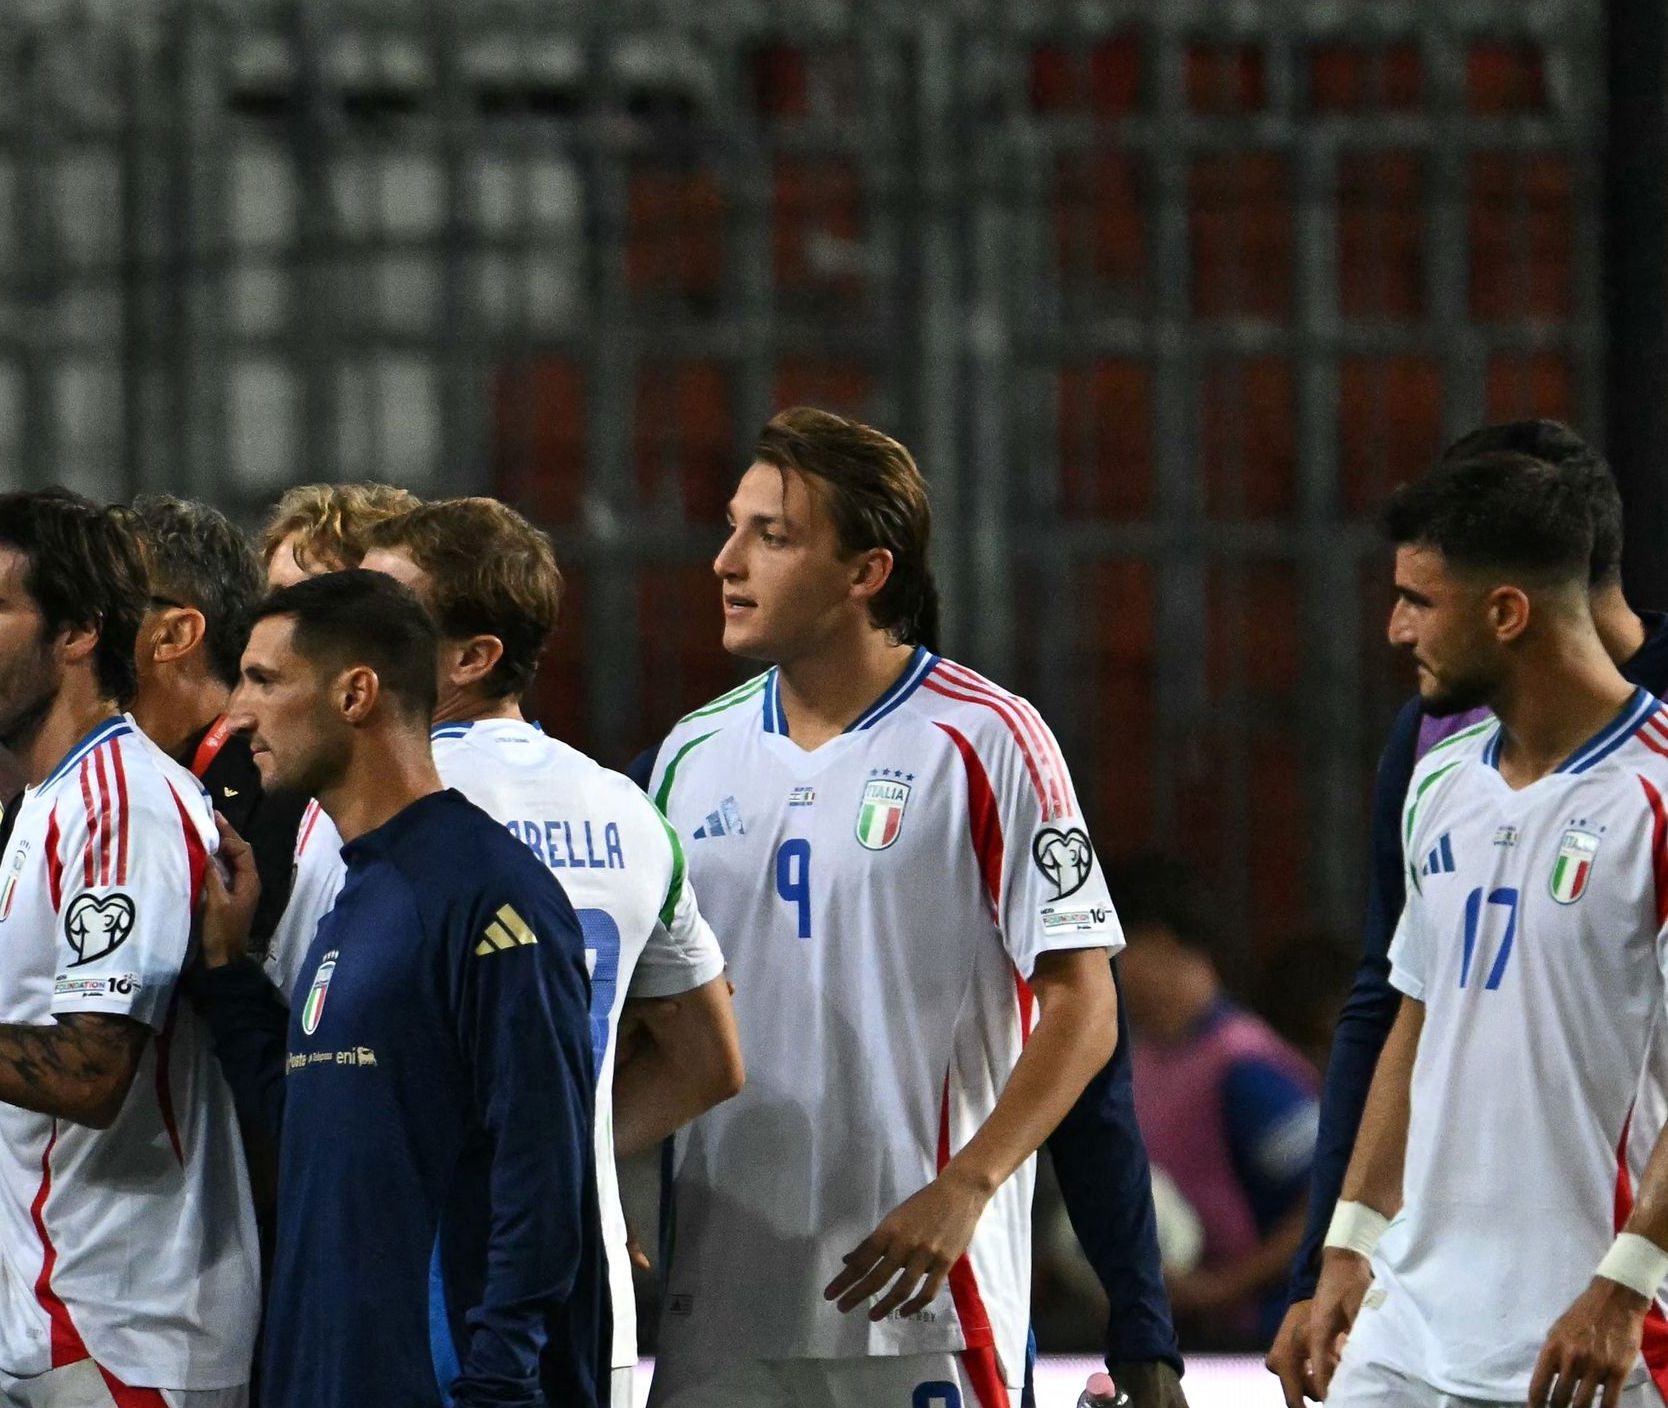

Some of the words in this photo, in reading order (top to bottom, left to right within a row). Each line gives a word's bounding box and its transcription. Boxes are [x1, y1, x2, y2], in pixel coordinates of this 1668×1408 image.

[776, 838, 813, 938] 9
[1459, 887, 1519, 990] 17
[336, 1047, 356, 1064] eni
